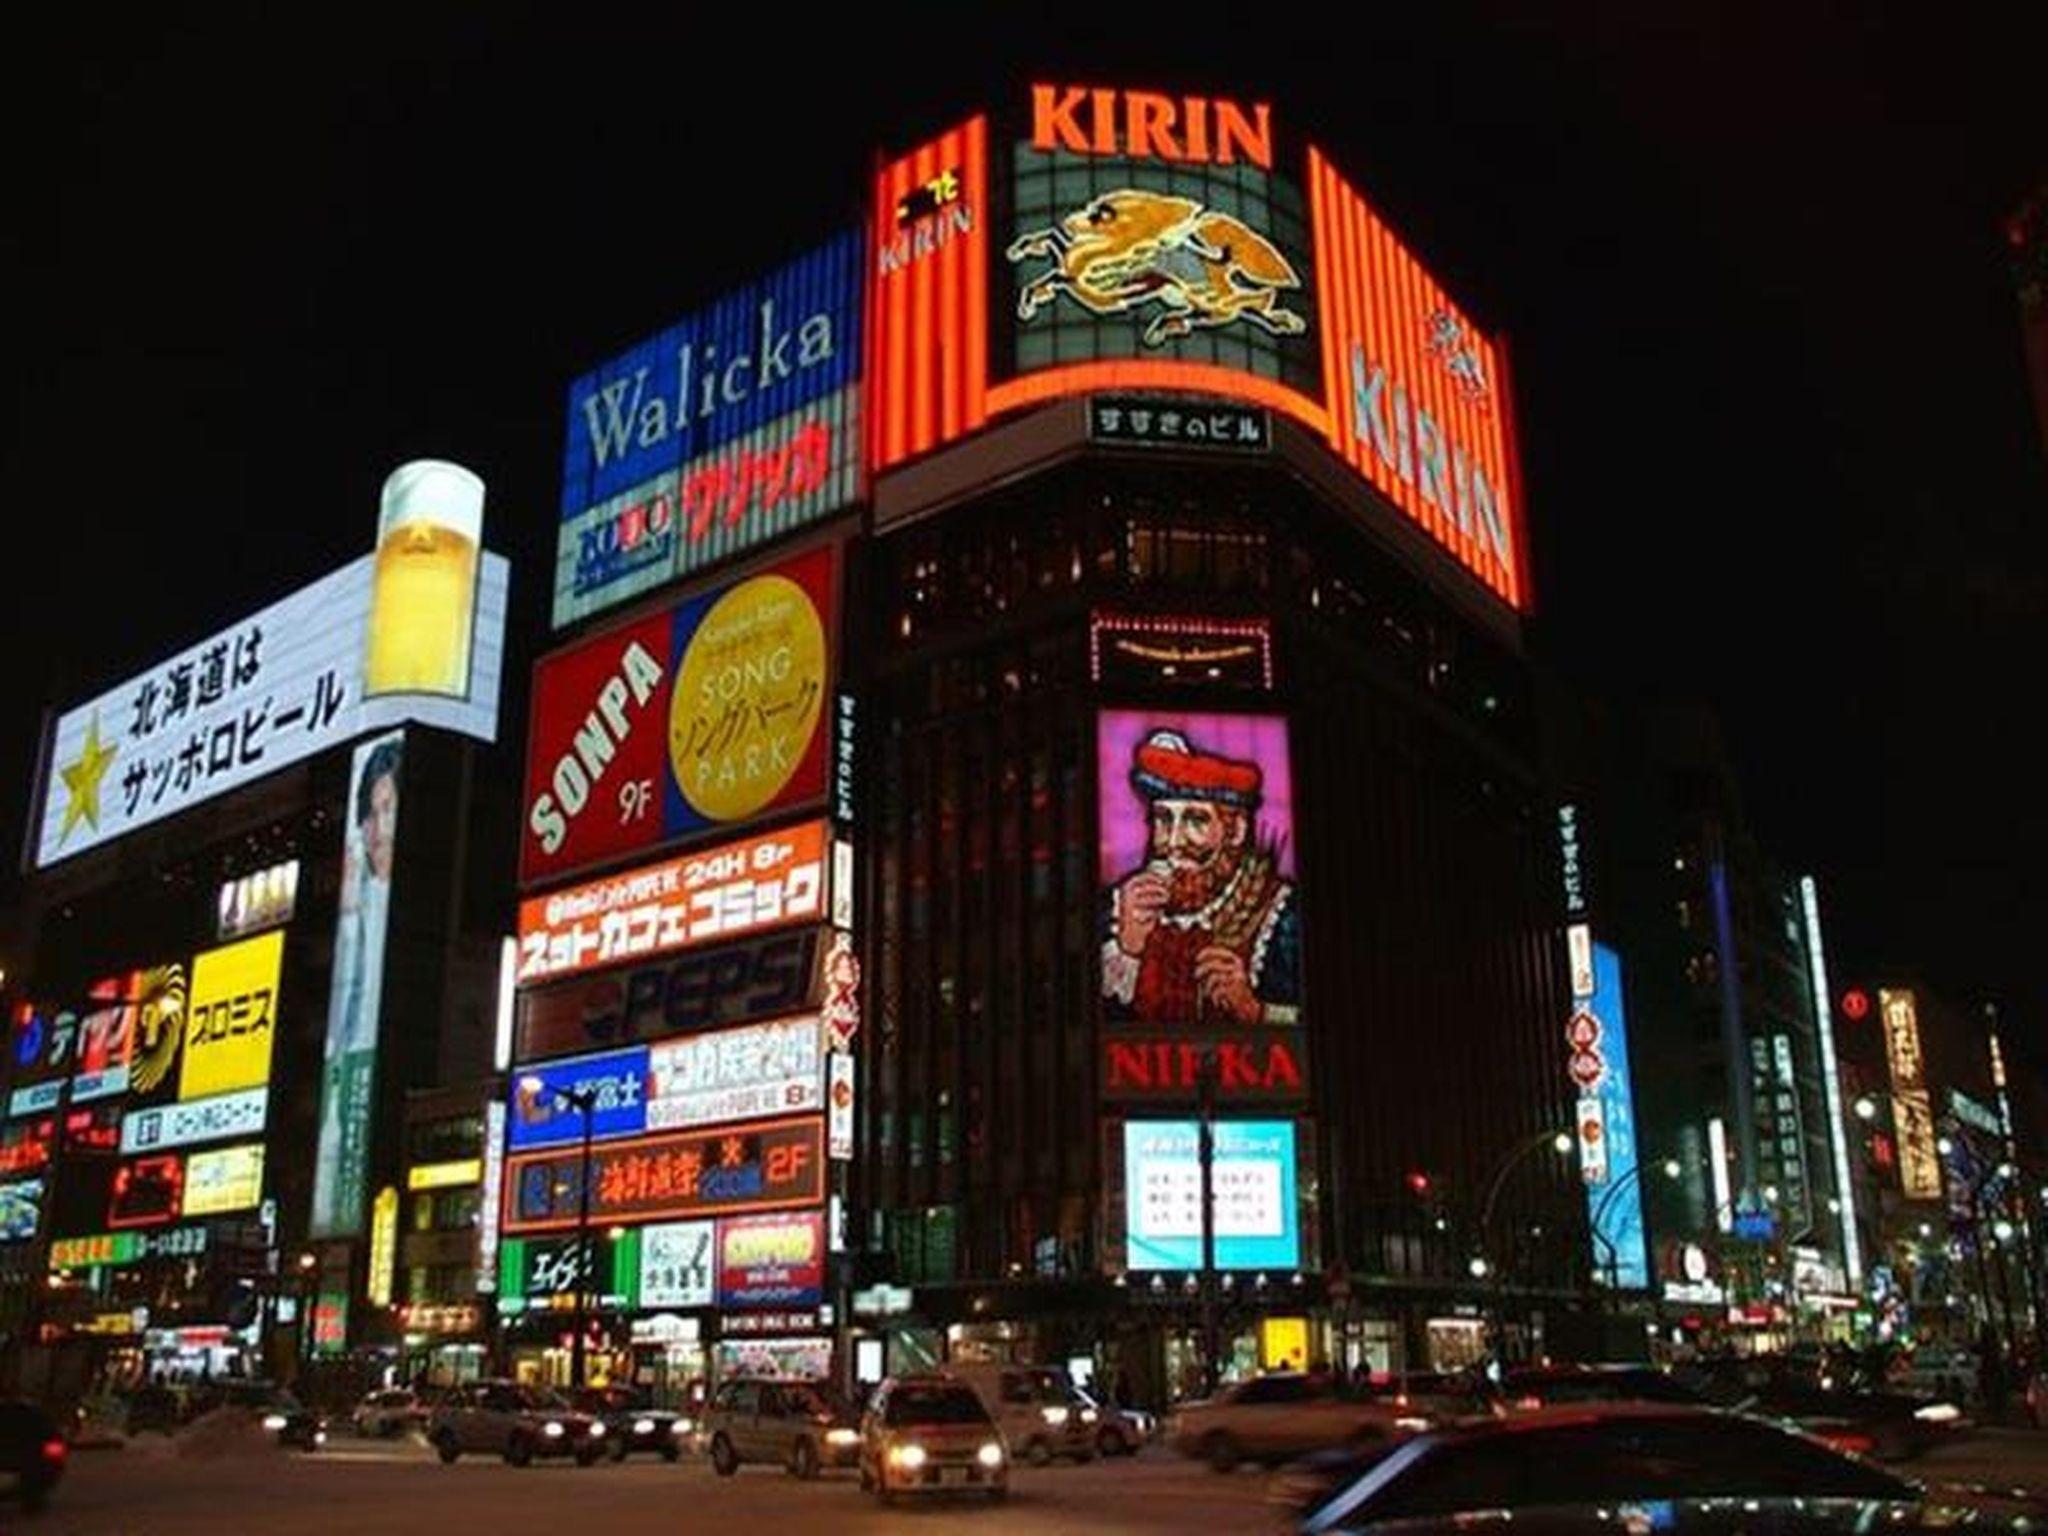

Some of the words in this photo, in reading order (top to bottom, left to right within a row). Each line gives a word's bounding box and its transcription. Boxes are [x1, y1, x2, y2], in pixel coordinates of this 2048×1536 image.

[1032, 83, 1272, 169] KIRIN
[878, 205, 973, 277] KIRIN
[582, 298, 834, 470] Walicka
[681, 419, 832, 546] ワリッカ
[1352, 345, 1514, 577] KIRIN
[128, 626, 263, 740] 北海道は
[701, 646, 793, 708] SONG
[121, 669, 345, 816] サッポロビール
[530, 641, 664, 855] SONPA
[695, 736, 790, 789] PARK
[618, 779, 653, 825] 9F
[190, 987, 273, 1047] プロミス
[1106, 1042, 1302, 1090] NIKA
[767, 1146, 807, 1182] 2F
